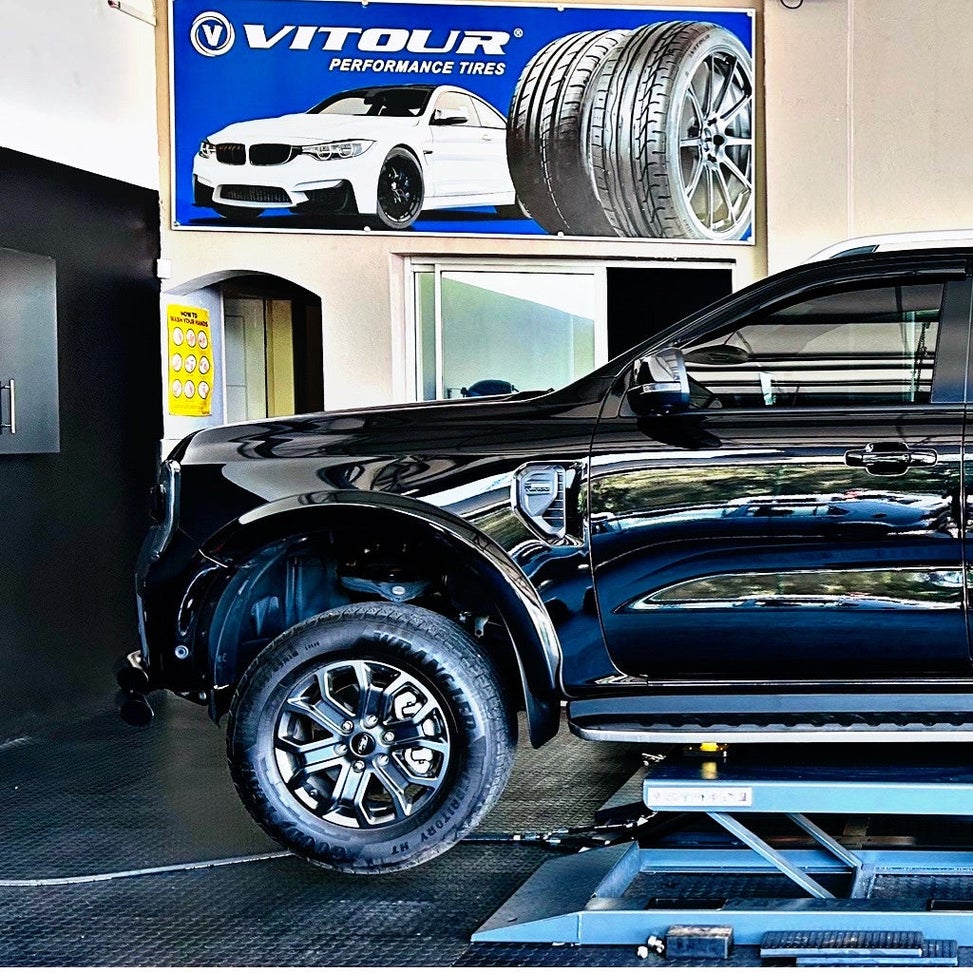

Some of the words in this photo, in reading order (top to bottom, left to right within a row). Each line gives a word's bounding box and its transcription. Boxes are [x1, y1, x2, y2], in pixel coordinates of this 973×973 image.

[243, 23, 511, 55] VITOUR
[328, 58, 454, 75] PERFORMANCE
[460, 60, 506, 76] TIRES
[373, 630, 478, 730] WRANGLER
